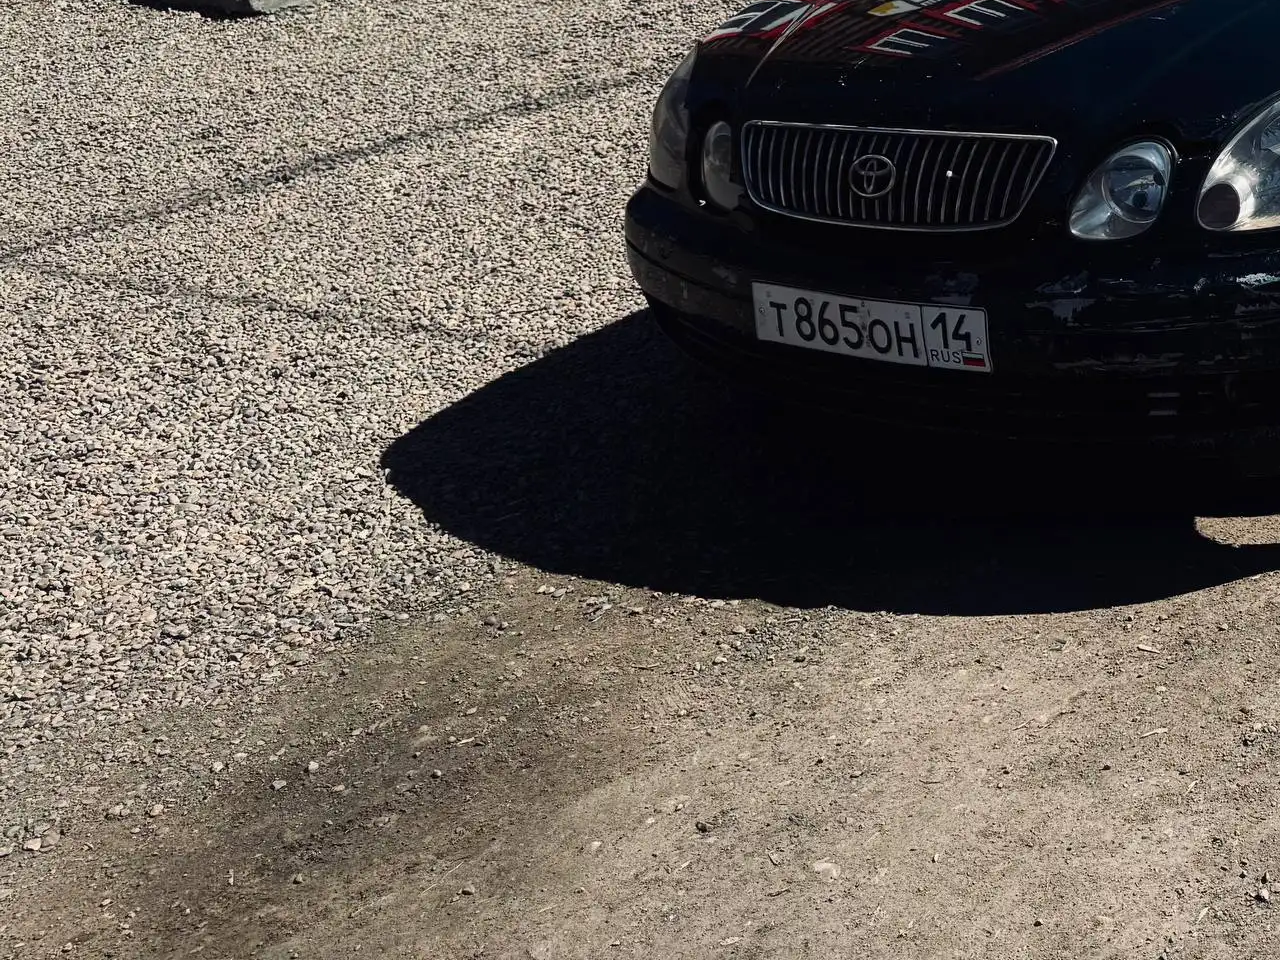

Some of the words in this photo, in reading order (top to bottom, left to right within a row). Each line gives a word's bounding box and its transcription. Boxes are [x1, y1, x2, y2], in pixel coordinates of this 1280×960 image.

[769, 297, 920, 359] Т865ОН
[930, 312, 973, 352] 14
[930, 348, 961, 364] RUS
